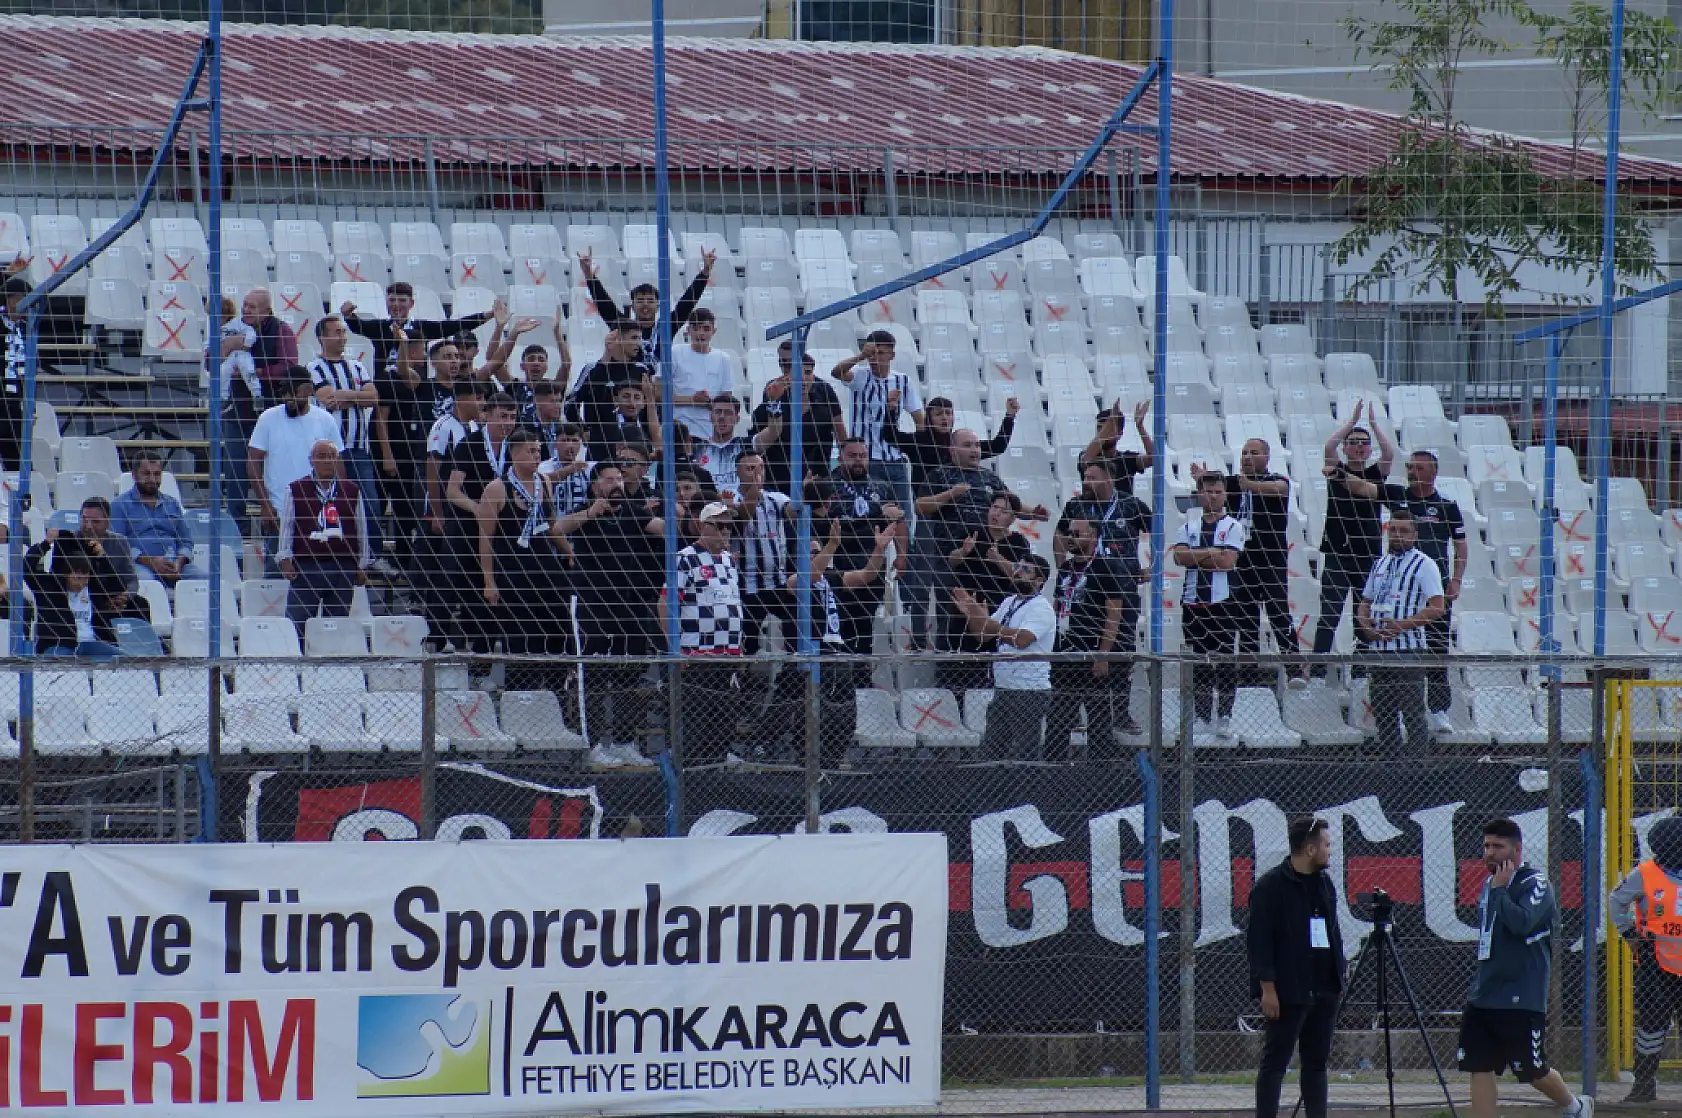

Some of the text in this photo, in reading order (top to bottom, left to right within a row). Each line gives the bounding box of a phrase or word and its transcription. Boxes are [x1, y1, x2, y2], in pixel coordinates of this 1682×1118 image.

[108, 915, 192, 976] ve
[209, 889, 374, 975] Tüm
[391, 884, 914, 987] Sporcularımıza
[784, 1055, 911, 1090] BAŞKANI
